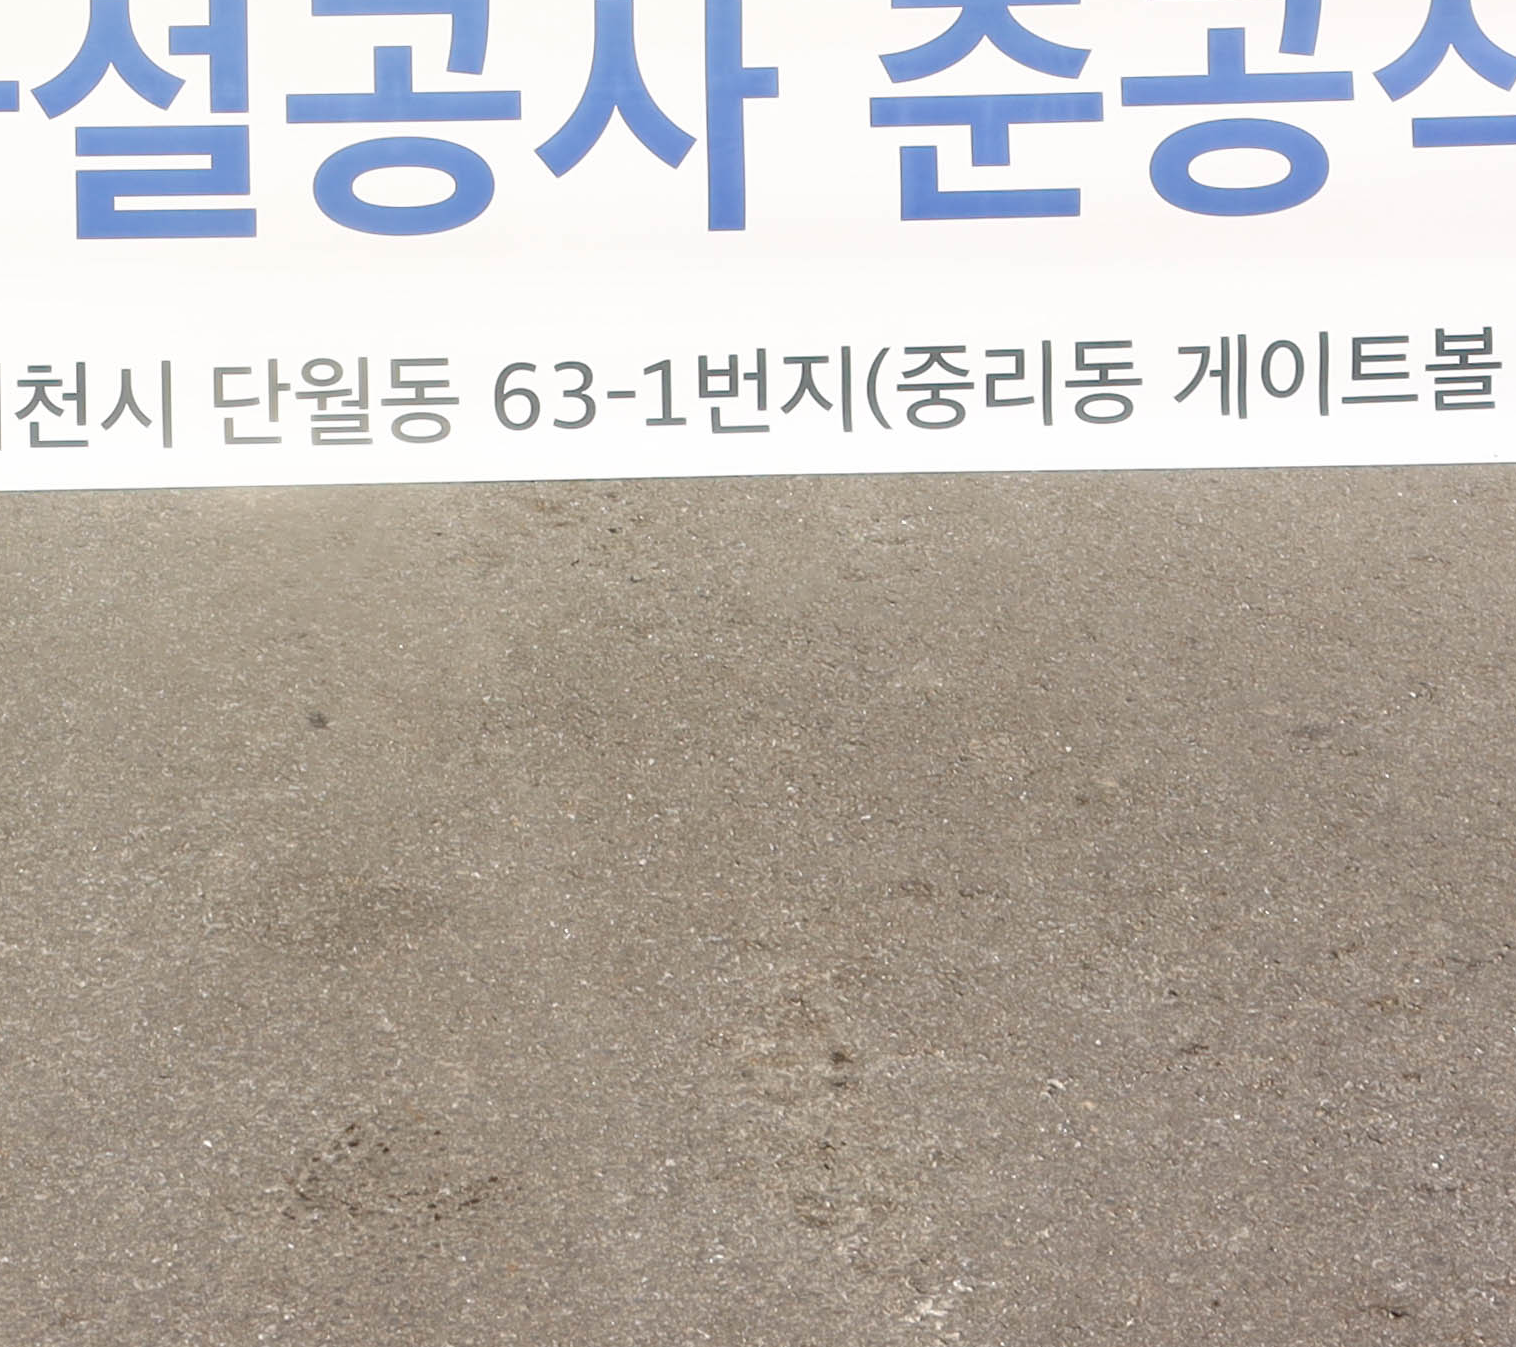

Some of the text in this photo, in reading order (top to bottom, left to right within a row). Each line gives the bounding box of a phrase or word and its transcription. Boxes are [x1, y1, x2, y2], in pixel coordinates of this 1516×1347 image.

[214, 357, 459, 445] 단월동
[495, 340, 1142, 433] 63-1번지(중리동
[1174, 327, 1502, 419] 게이트볼
